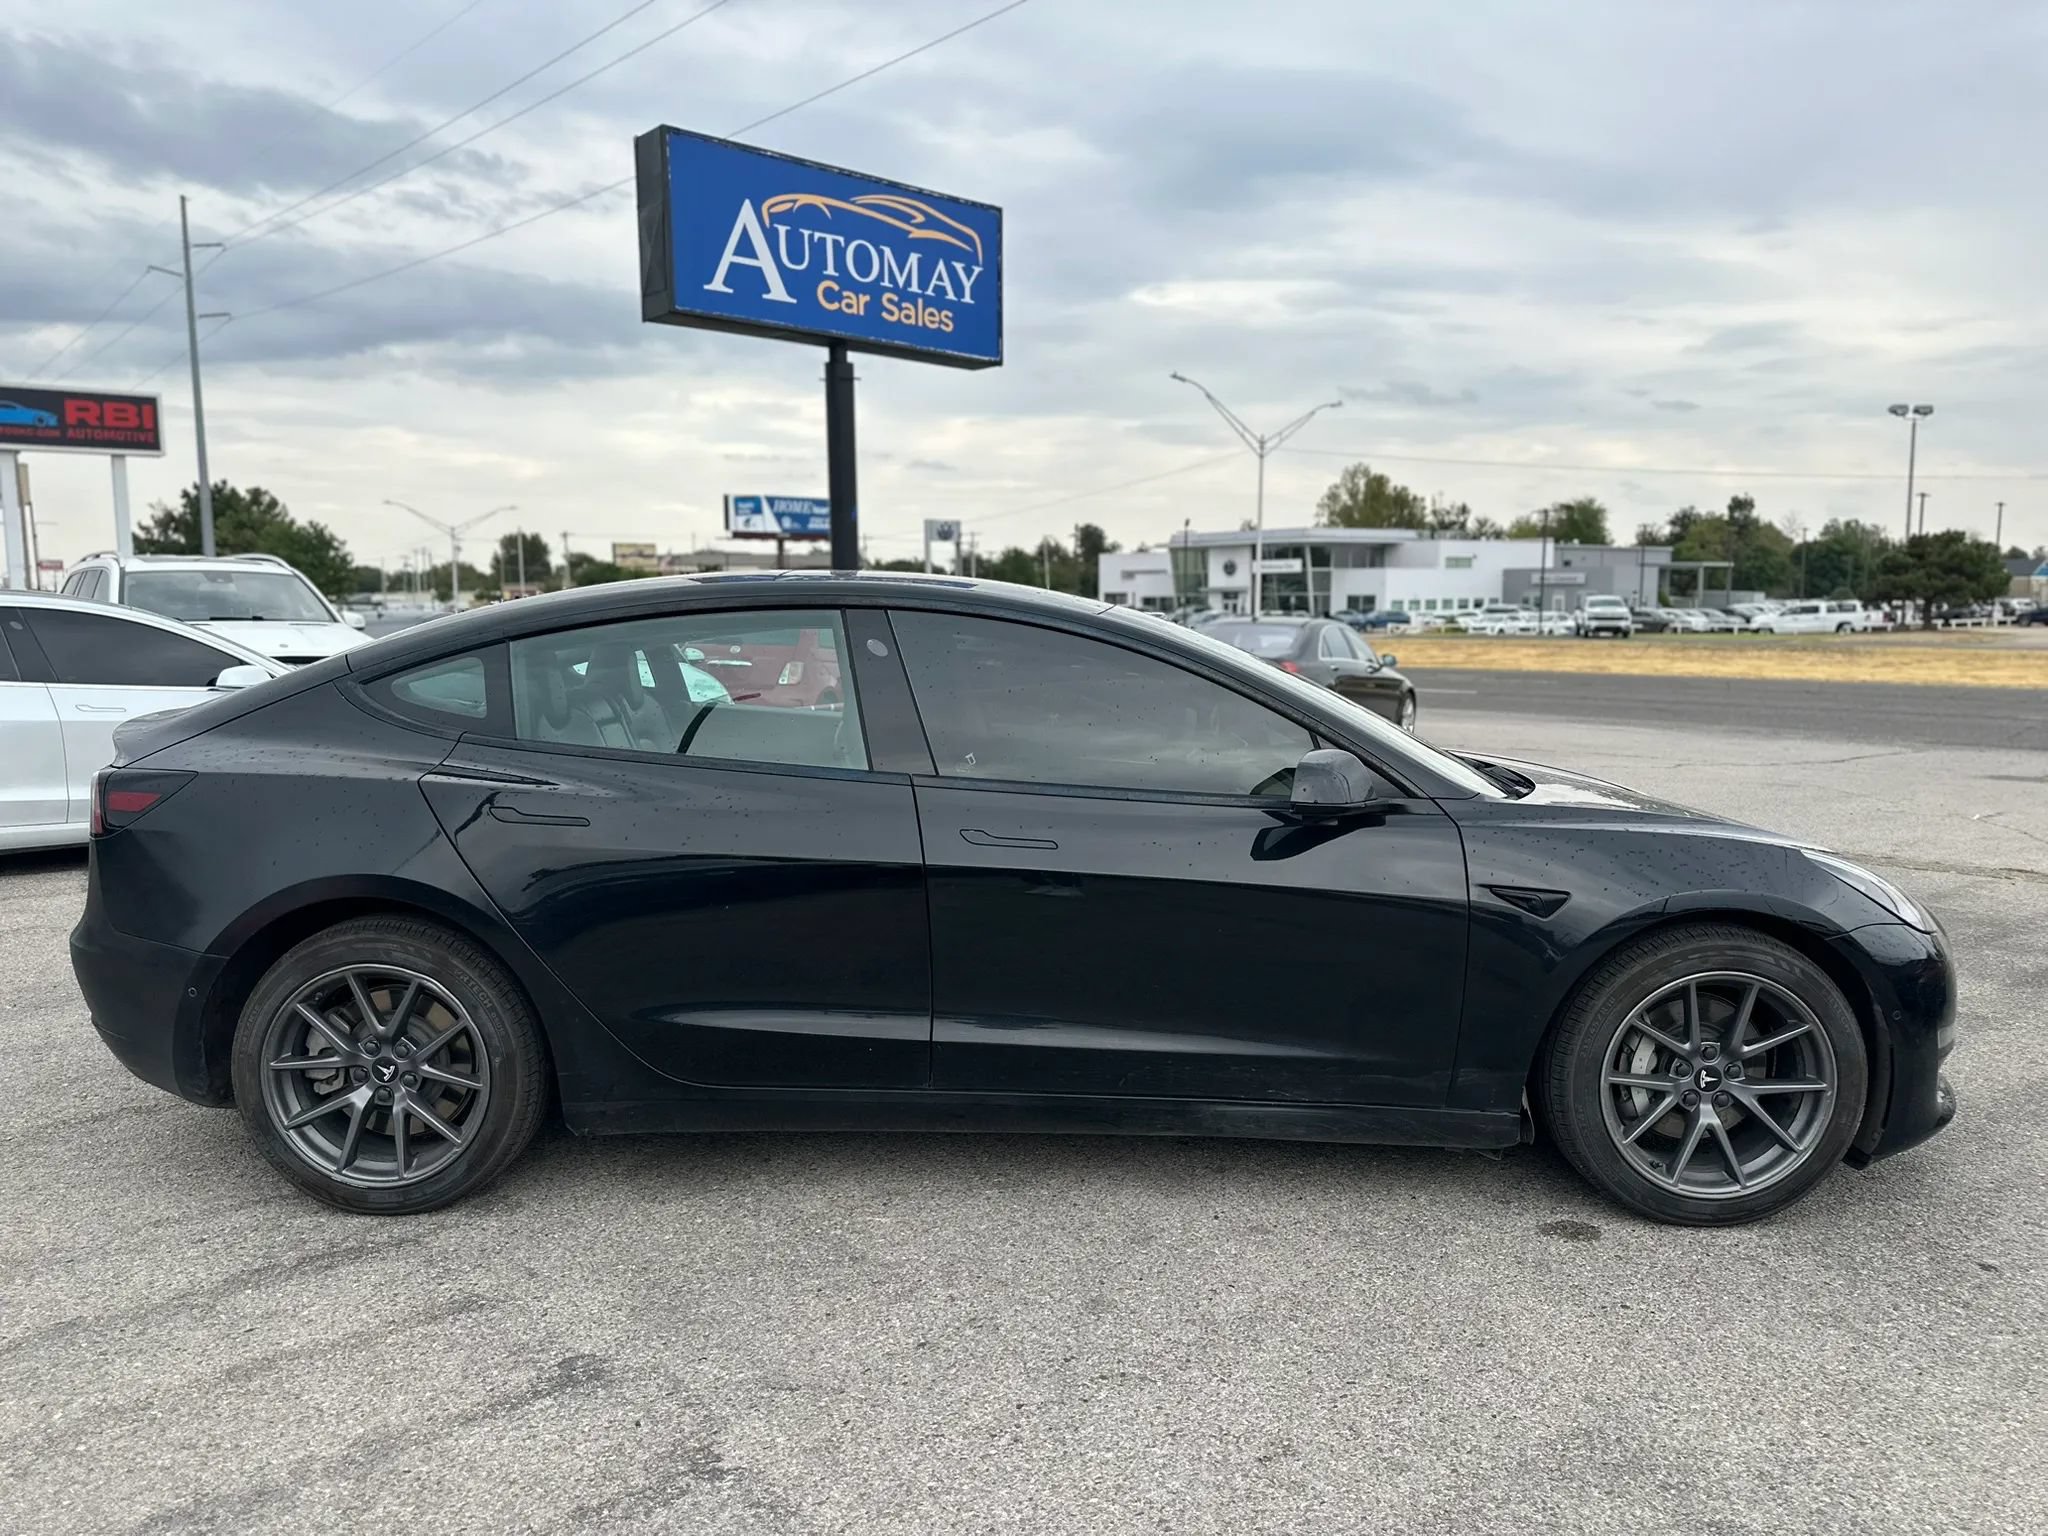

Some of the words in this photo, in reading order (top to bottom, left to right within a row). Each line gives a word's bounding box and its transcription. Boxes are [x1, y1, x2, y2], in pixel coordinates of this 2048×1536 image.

[703, 198, 984, 305] AUTOMAY
[816, 279, 871, 316] Car
[881, 293, 954, 333] Sales
[64, 399, 154, 430] RBI
[67, 427, 155, 444] AUTOMOTIVE
